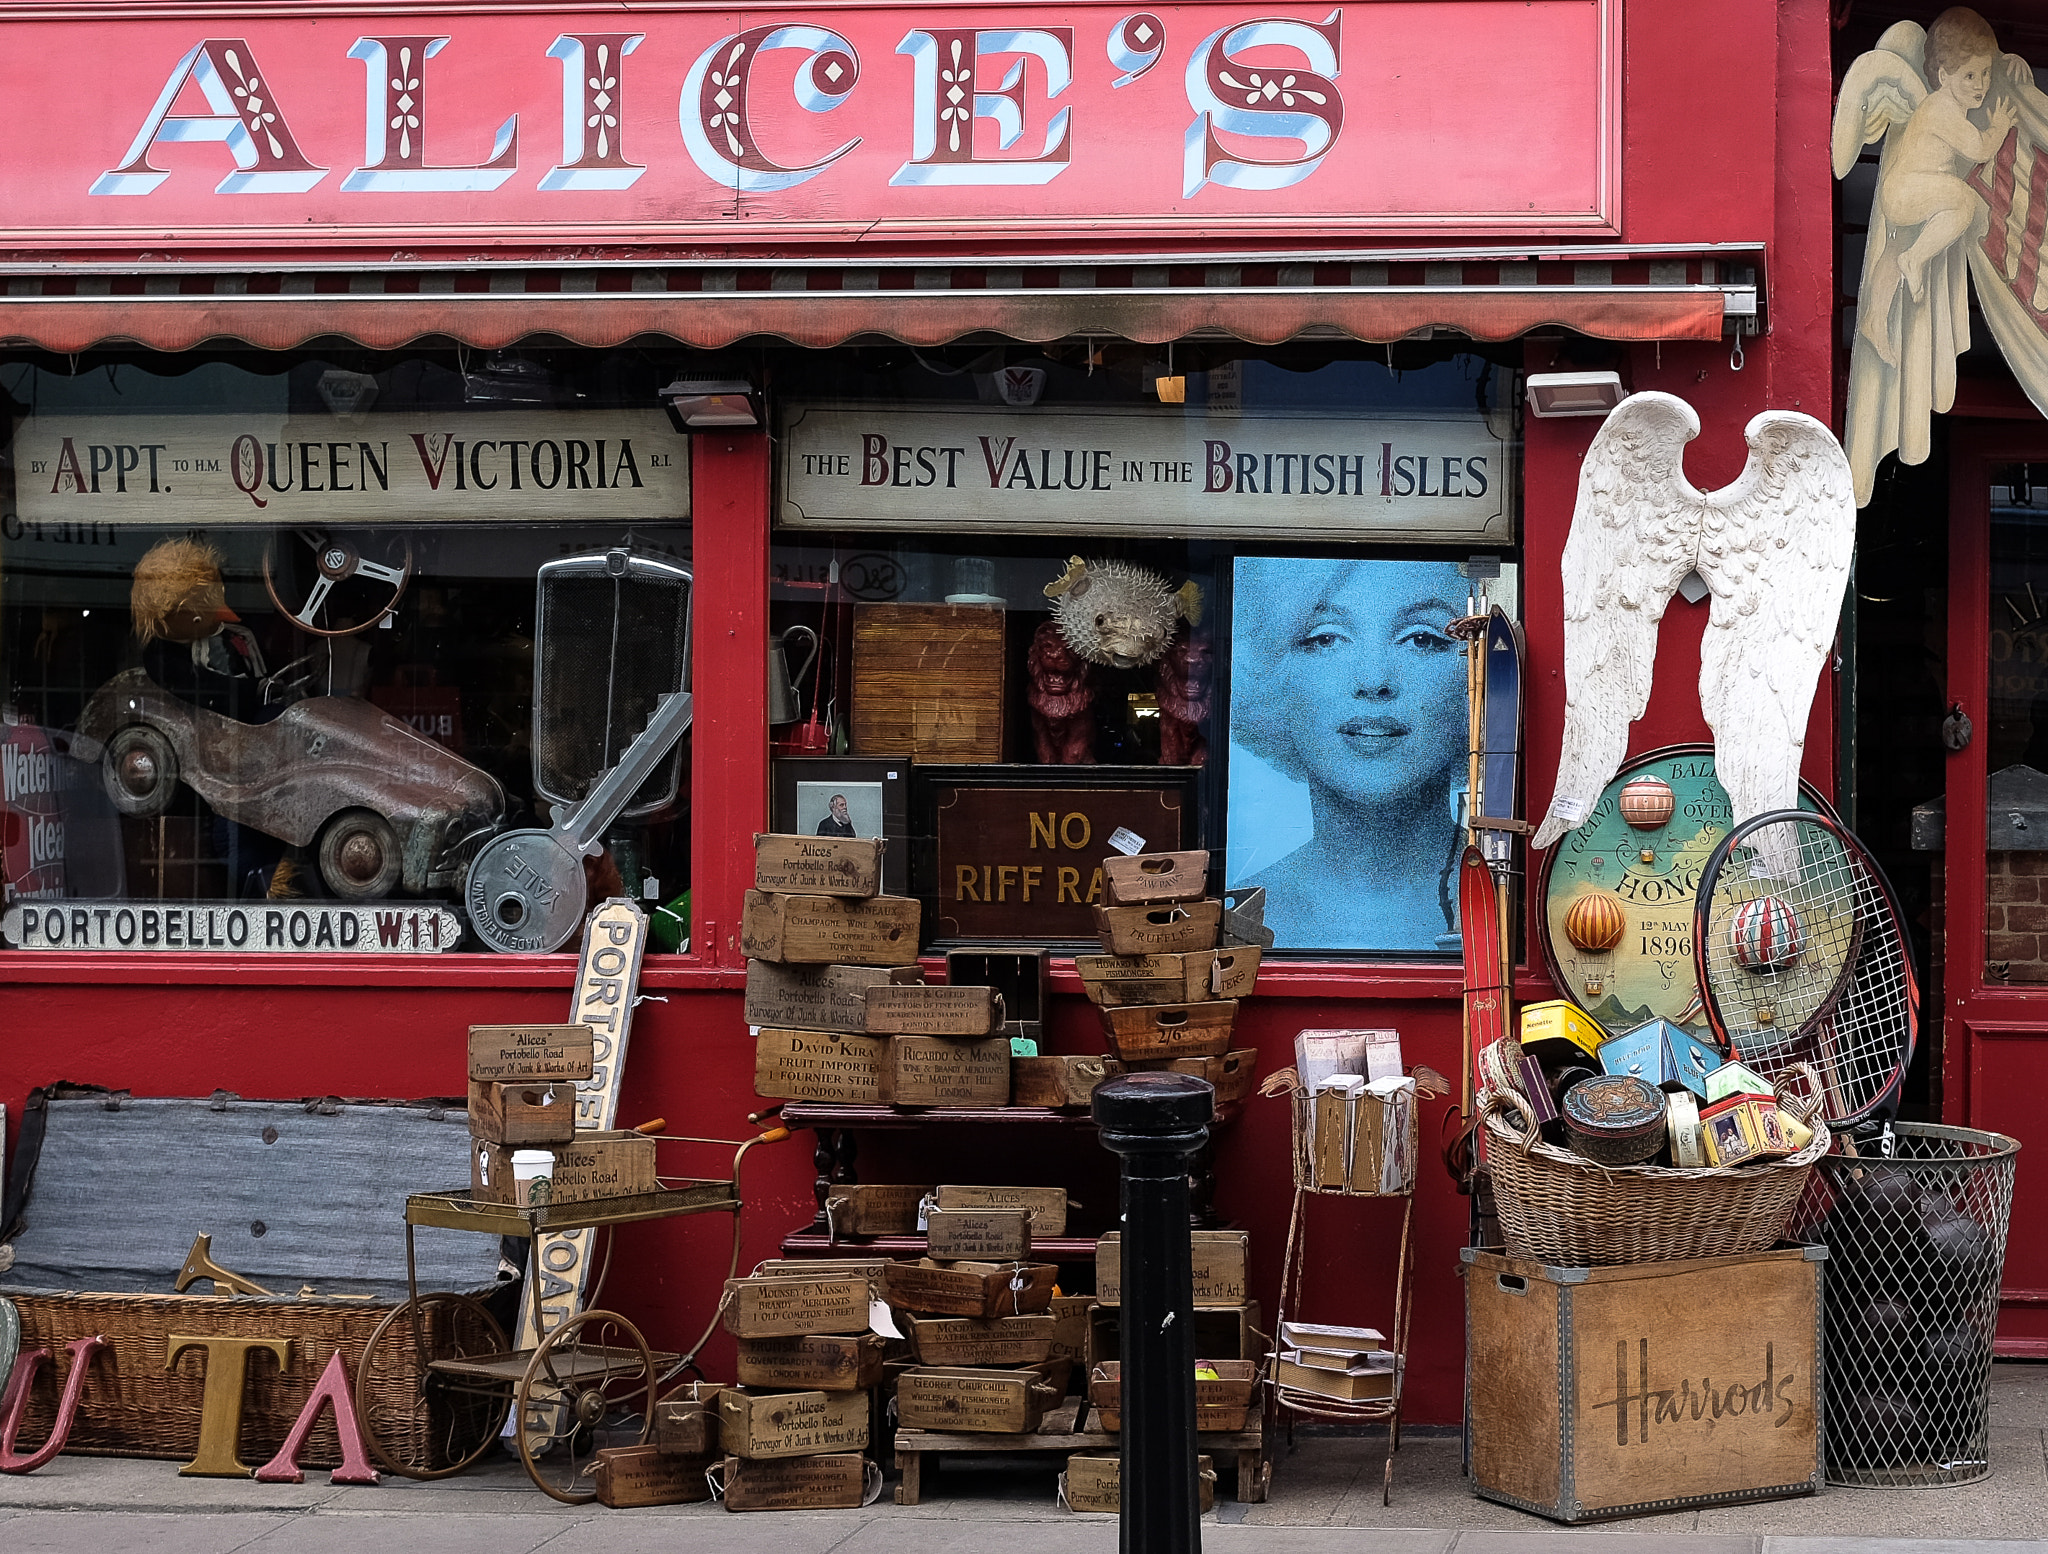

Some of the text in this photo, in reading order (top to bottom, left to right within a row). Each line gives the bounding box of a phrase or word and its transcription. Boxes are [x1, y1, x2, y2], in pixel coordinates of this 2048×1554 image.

[87, 7, 1344, 200] ALICE'S
[31, 461, 48, 474] BY
[173, 460, 190, 472] TO
[229, 433, 390, 509] QUEEN
[408, 432, 645, 491] VICTORIA
[802, 452, 850, 477] THE
[859, 432, 966, 490] BEST
[976, 434, 1113, 491] VALUE
[1122, 461, 1144, 484] IN
[1150, 460, 1194, 484] THE
[1201, 438, 1365, 496] BRITISH
[1683, 803, 1733, 819] OVER
[1028, 811, 1091, 850] NO
[1570, 797, 1616, 854] GRAND
[504, 855, 561, 914] YALE
[955, 864, 1103, 904] RIFF RA
[20, 907, 442, 949] PORTOBELLO ROAD W11
[1129, 925, 1195, 943] TRUFFLES
[1661, 921, 1690, 933] MAY
[1640, 936, 1692, 956] 1896
[1200, 970, 1246, 991] OTERS
[500, 1047, 564, 1060] Portobello Road
[790, 1037, 834, 1055] DAVID
[903, 1045, 949, 1062] RICARDO
[952, 1047, 966, 1061] &
[779, 1056, 815, 1070] FRUIT
[780, 1071, 843, 1084] FOURNIER
[848, 1074, 878, 1086] STRE
[928, 1073, 952, 1085] MARY
[958, 1074, 970, 1085] AT
[975, 1073, 994, 1085] HILL
[794, 1086, 844, 1098] LONDON
[934, 1086, 972, 1098] LONDON
[591, 1168, 619, 1184] Road
[1191, 1266, 1210, 1279] oad
[1192, 1283, 1211, 1297] orks
[1226, 1283, 1240, 1297] Art
[758, 1297, 851, 1311] BRANDY MERCHANTS
[761, 1312, 779, 1321] OLD
[746, 1356, 778, 1366] COVENT
[768, 1369, 800, 1379] LONDON
[913, 1377, 953, 1390] GEORGE
[1591, 1336, 1795, 1447] Harrods
[973, 1407, 1008, 1416] MARKET
[776, 1415, 844, 1432] Portobello Road
